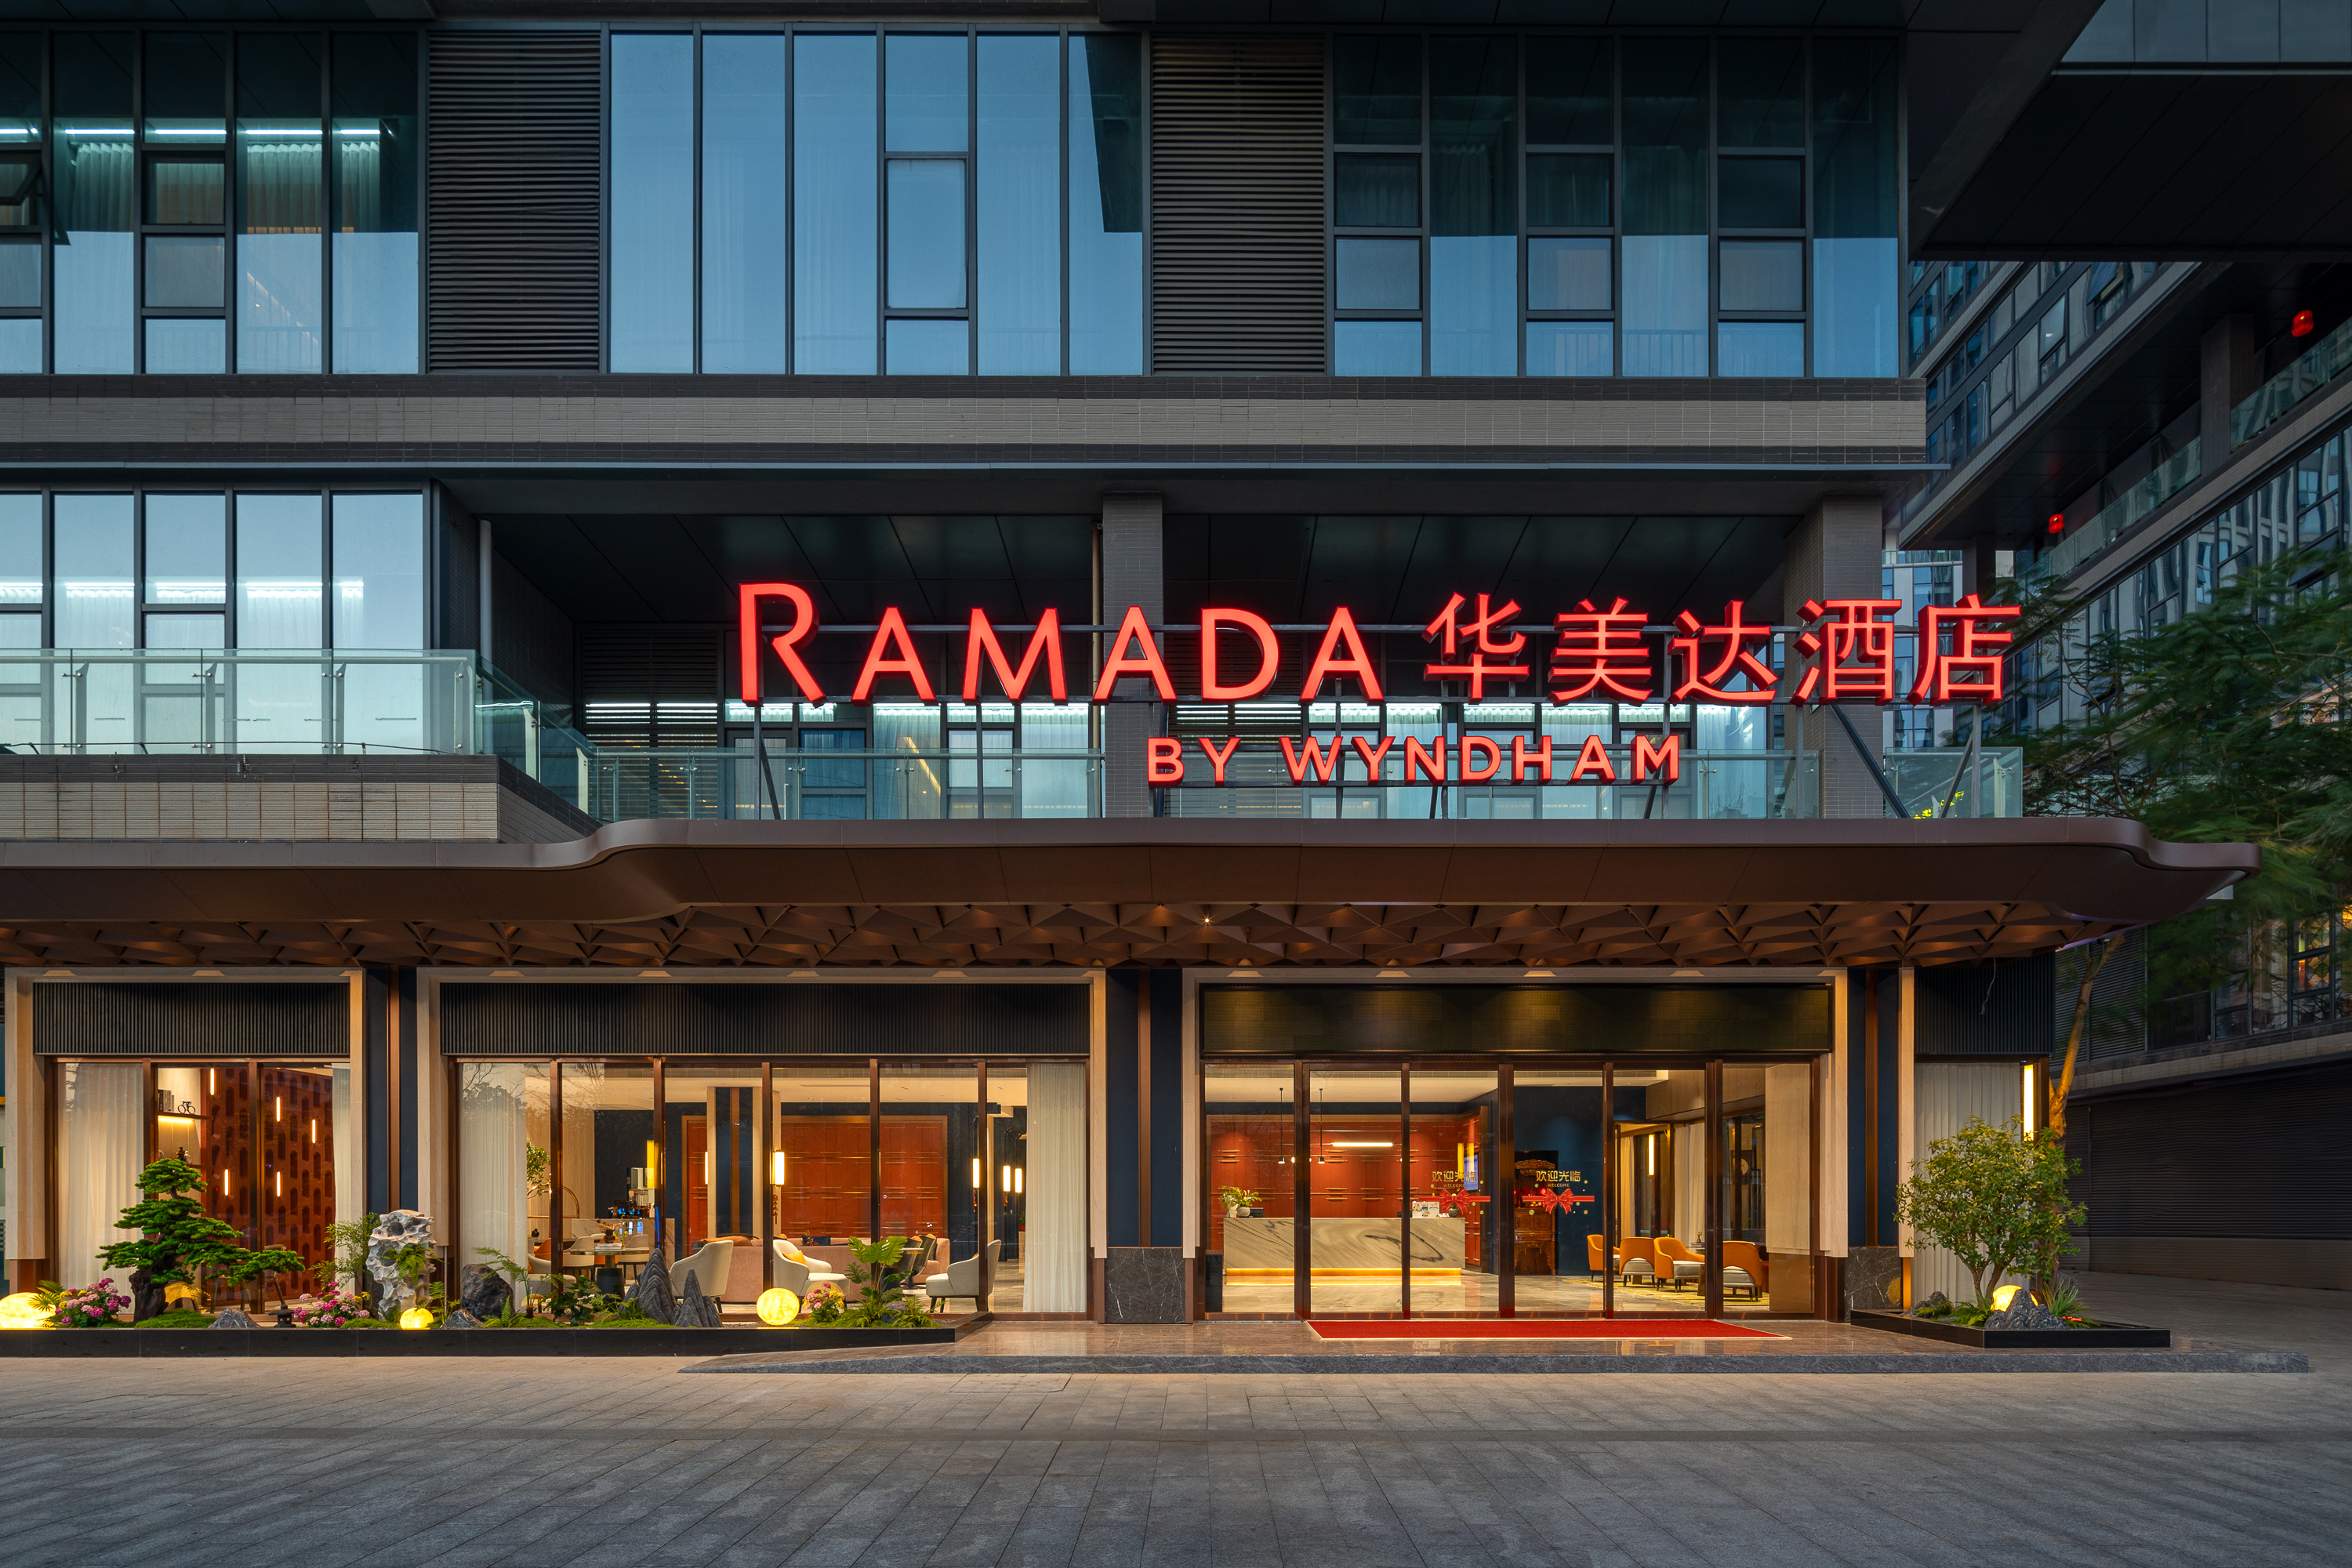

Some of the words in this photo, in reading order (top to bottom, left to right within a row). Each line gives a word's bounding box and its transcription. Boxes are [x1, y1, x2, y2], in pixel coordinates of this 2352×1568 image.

[739, 583, 1384, 707] RAMADA
[1422, 592, 2021, 707] 华美达酒店
[1147, 736, 1241, 786] BY
[1279, 735, 1679, 786] WYNDHAM
[1432, 1171, 1477, 1182] 欢迎光临
[1536, 1171, 1581, 1182] 欢迎光临
